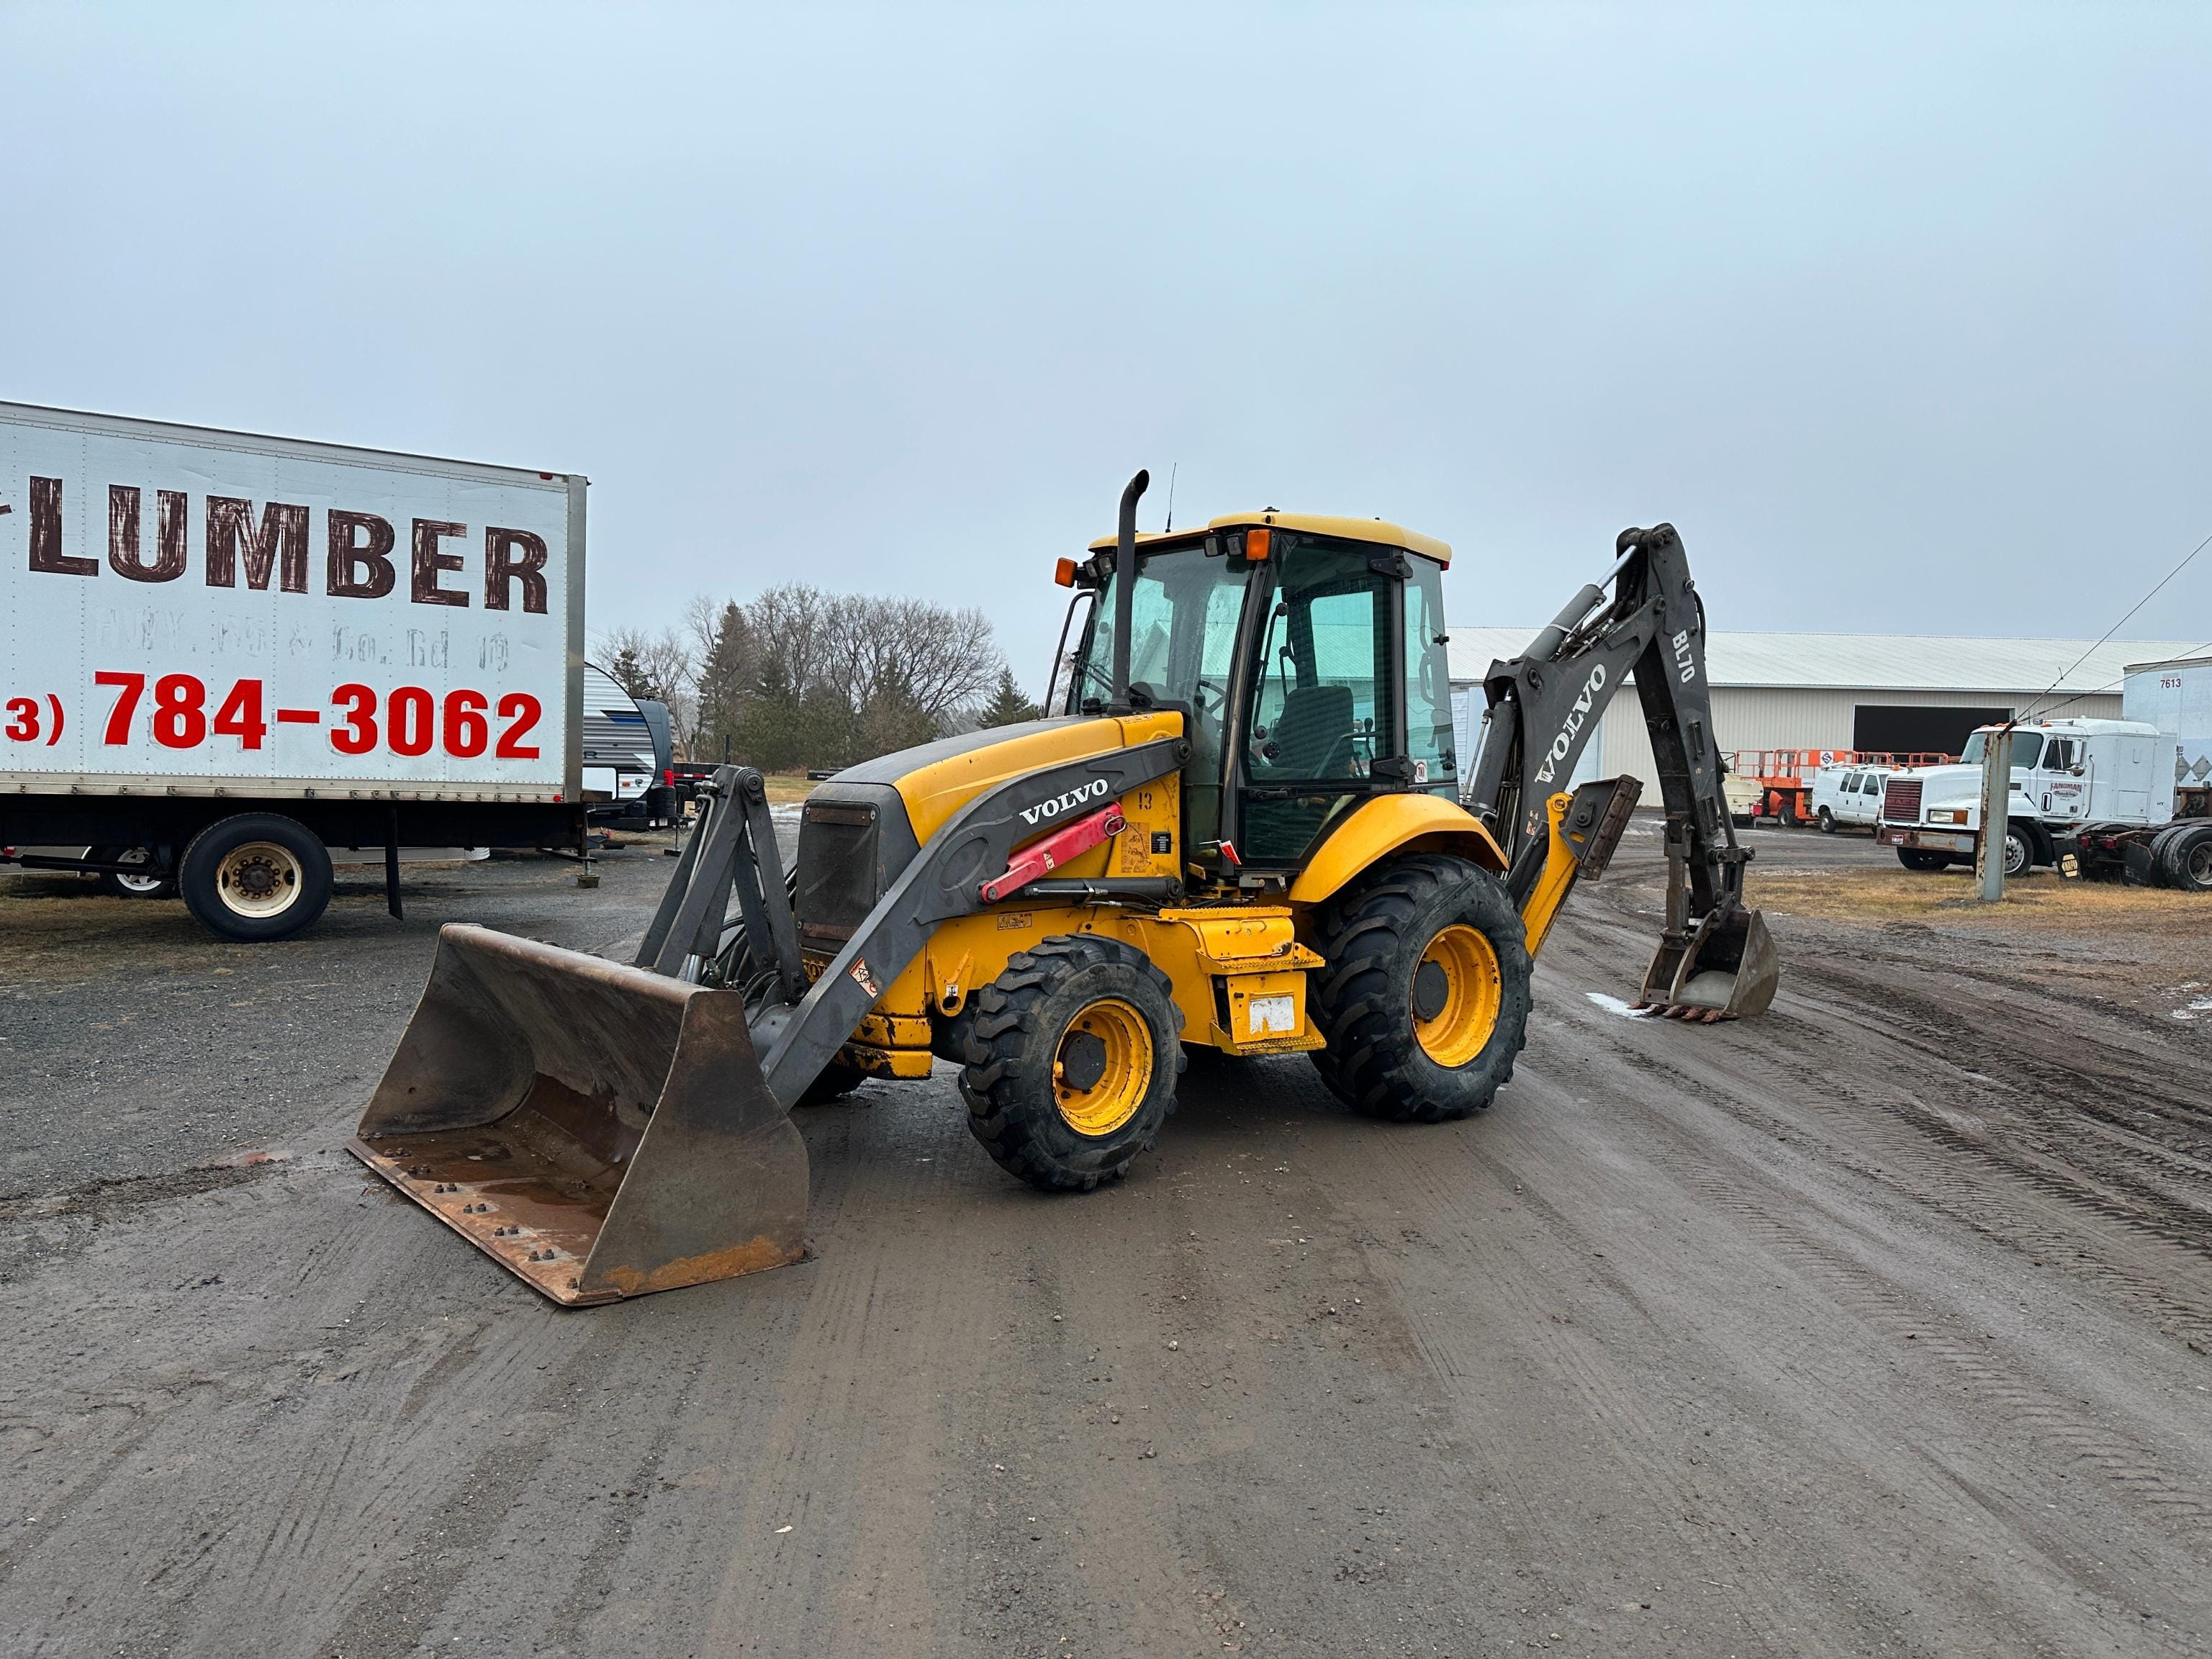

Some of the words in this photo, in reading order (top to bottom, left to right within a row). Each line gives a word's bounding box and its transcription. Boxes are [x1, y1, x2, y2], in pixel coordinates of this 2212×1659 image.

[30, 475, 549, 615] LUMBER
[1672, 630, 1695, 684] BL70
[2160, 678, 2182, 689] 7613
[96, 672, 541, 758] 784-3062
[1534, 664, 1607, 784] VOLVO
[1019, 779, 1109, 826] VOLVO
